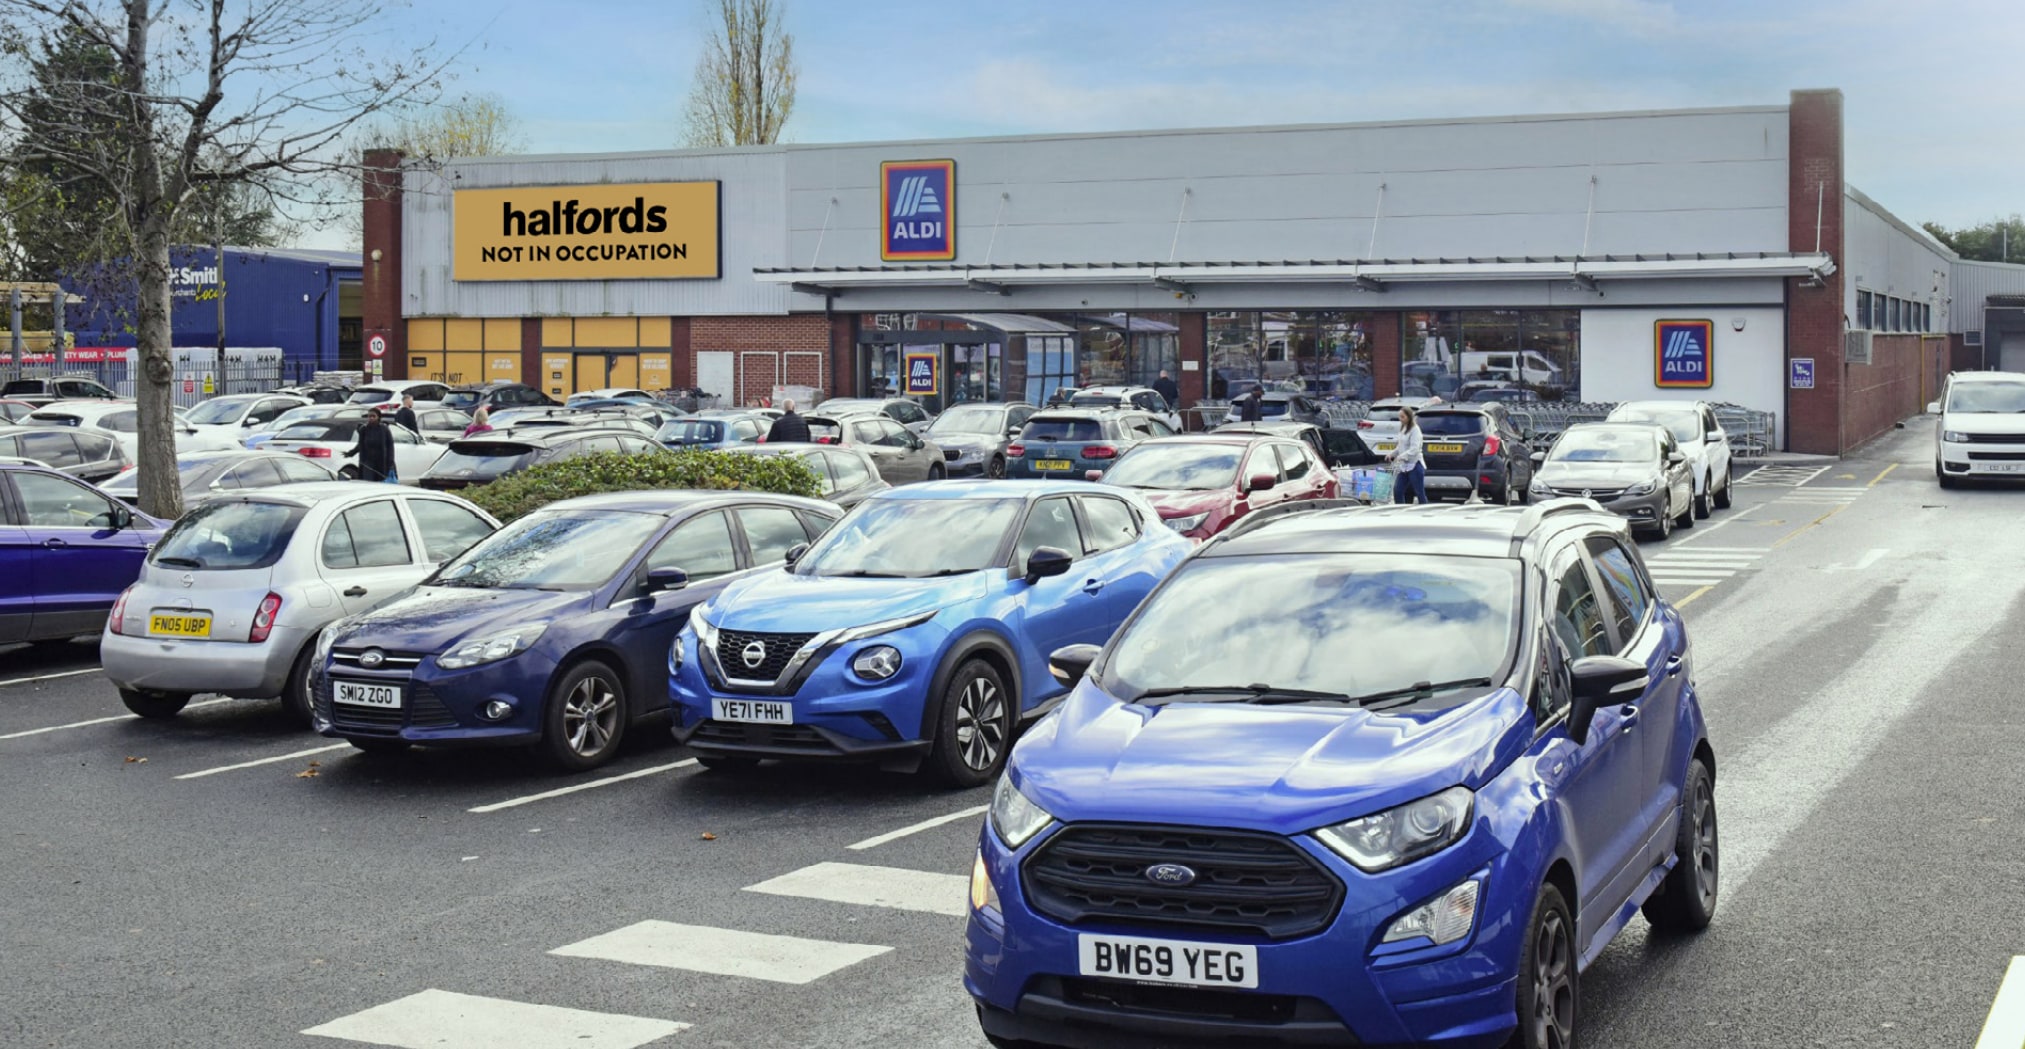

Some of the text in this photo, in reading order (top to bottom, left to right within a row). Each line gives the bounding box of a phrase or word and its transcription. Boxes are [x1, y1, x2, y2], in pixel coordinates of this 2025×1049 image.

[503, 197, 667, 236] halfords
[893, 221, 942, 239] ALDI
[482, 243, 687, 262] NOT IN OCCUPATION
[372, 341, 383, 351] 10
[79, 351, 97, 359] WEAR
[1664, 361, 1702, 373] ALDI
[911, 378, 932, 387] ALDI
[153, 617, 206, 633] FN05 UBP
[340, 685, 393, 704] SM12 ZGO
[720, 701, 784, 720] YE71 FHH
[1155, 866, 1183, 881] Ford
[1094, 941, 1245, 983] BW69 YEG
